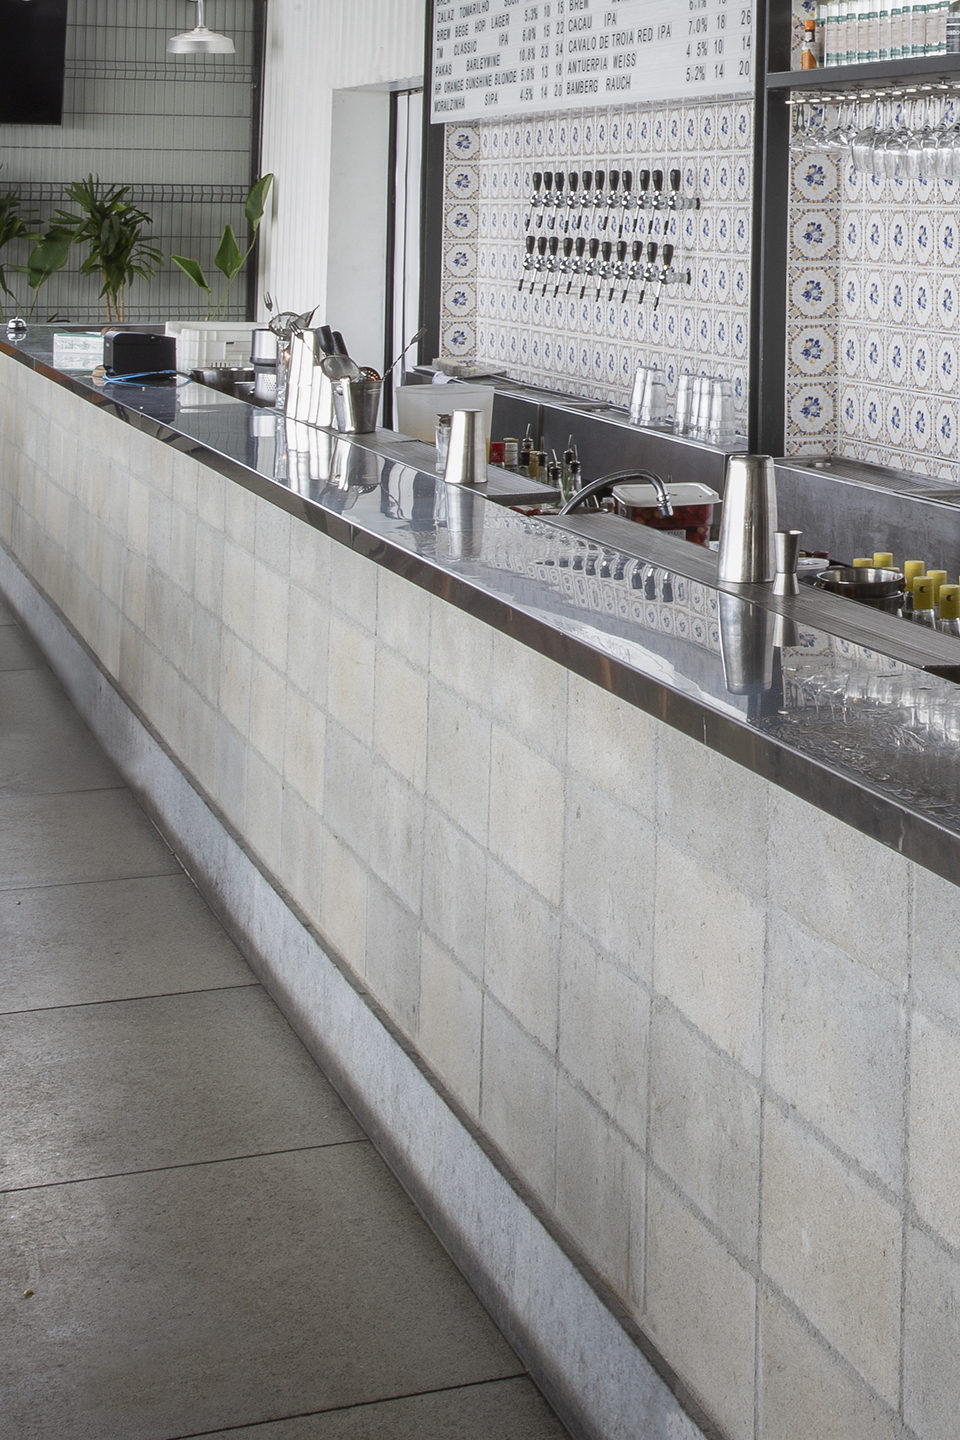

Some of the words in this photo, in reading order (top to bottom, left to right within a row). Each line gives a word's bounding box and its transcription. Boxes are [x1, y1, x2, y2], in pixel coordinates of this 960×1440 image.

[437, 9, 455, 24] ZALAZ
[455, 24, 469, 38] BEGE
[475, 19, 486, 34] HOP
[491, 13, 510, 30] LAGER
[568, 16, 592, 32] CACAU
[604, 12, 617, 27] IPA
[568, 36, 596, 53] CAVALO
[599, 34, 609, 49] DE
[612, 30, 634, 47] TROIA
[637, 27, 653, 42] RED
[658, 24, 672, 40] IPA
[688, 18, 707, 35] 7.0%
[717, 14, 725, 29] 18
[741, 9, 751, 25] 26
[453, 40, 478, 56] CLASSIC
[499, 33, 509, 47] IPA
[568, 56, 608, 74] ANTUERPIA
[613, 53, 636, 69] WEISS
[714, 39, 723, 54] 10
[742, 35, 751, 50] 14
[435, 63, 452, 77] PAKAS
[494, 70, 517, 86] BLONDE
[567, 79, 598, 95] BAMBERG
[606, 75, 631, 91] RAUCH
[686, 65, 706, 81] 5.2%
[715, 63, 724, 78] 14
[739, 60, 750, 76] 20
[485, 92, 498, 106] SIPA
